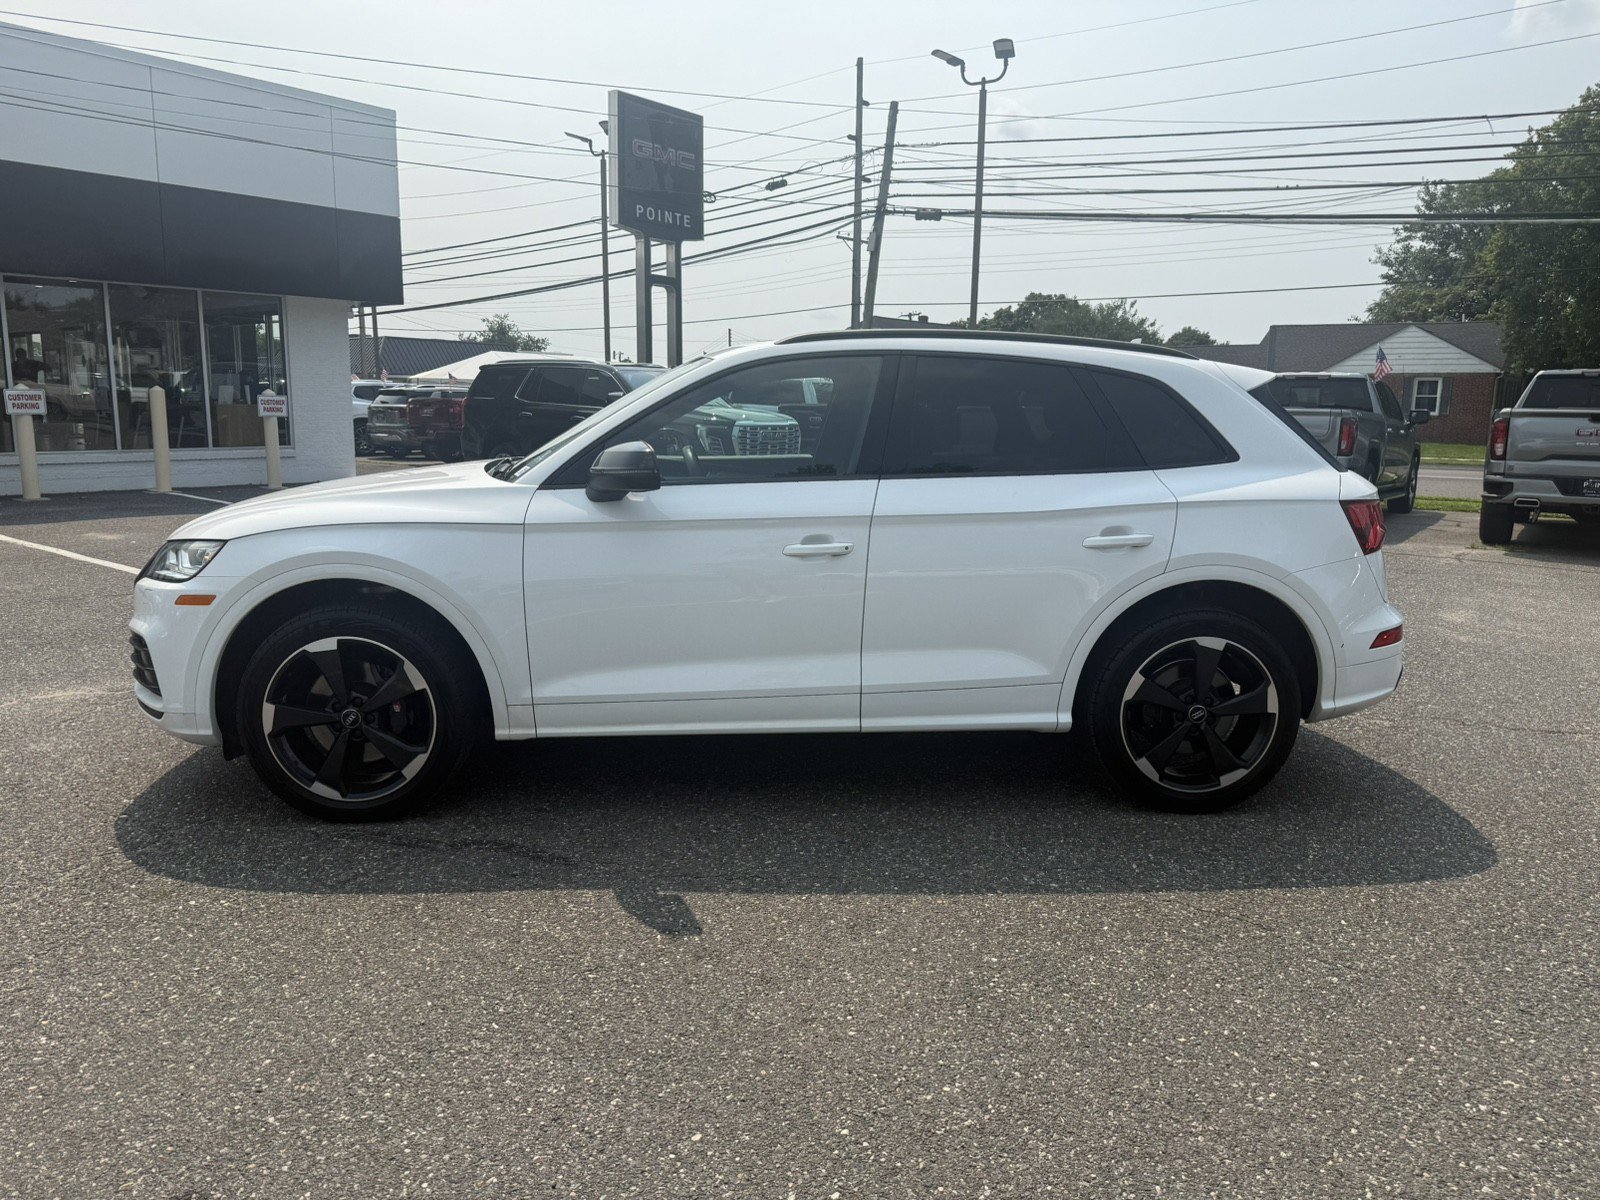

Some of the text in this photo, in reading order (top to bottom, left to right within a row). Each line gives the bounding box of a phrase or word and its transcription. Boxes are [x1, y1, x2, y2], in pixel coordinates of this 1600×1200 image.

[632, 138, 696, 171] GMC
[636, 204, 691, 228] POINTE
[7, 393, 43, 401] CUSTOMER
[12, 402, 40, 410] PARKING
